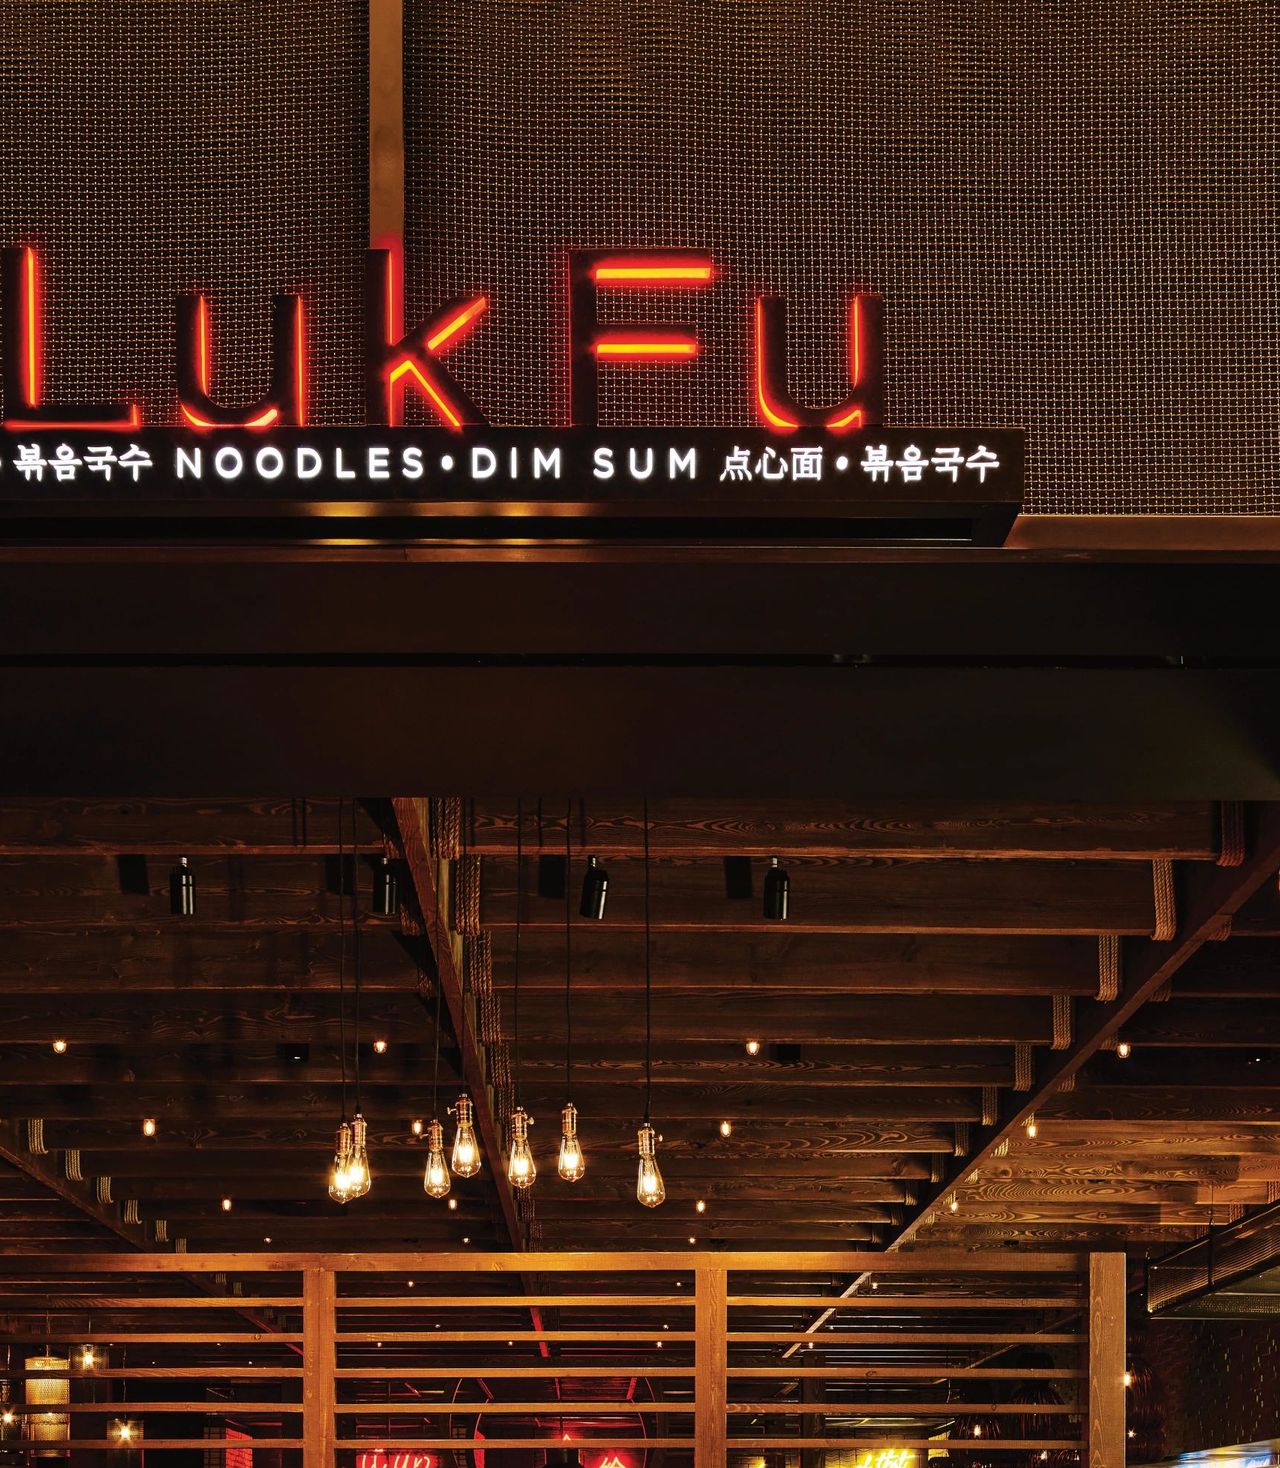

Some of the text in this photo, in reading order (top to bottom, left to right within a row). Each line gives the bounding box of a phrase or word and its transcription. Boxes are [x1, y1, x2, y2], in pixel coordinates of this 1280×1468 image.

[3, 246, 885, 427] Luk Fu
[13, 443, 153, 482] 볶음국수
[176, 446, 425, 480] NOODLES
[471, 446, 562, 480] DIM
[592, 446, 698, 480] SUM
[720, 446, 823, 482] 点心面
[860, 444, 1001, 484] 볶음국수
